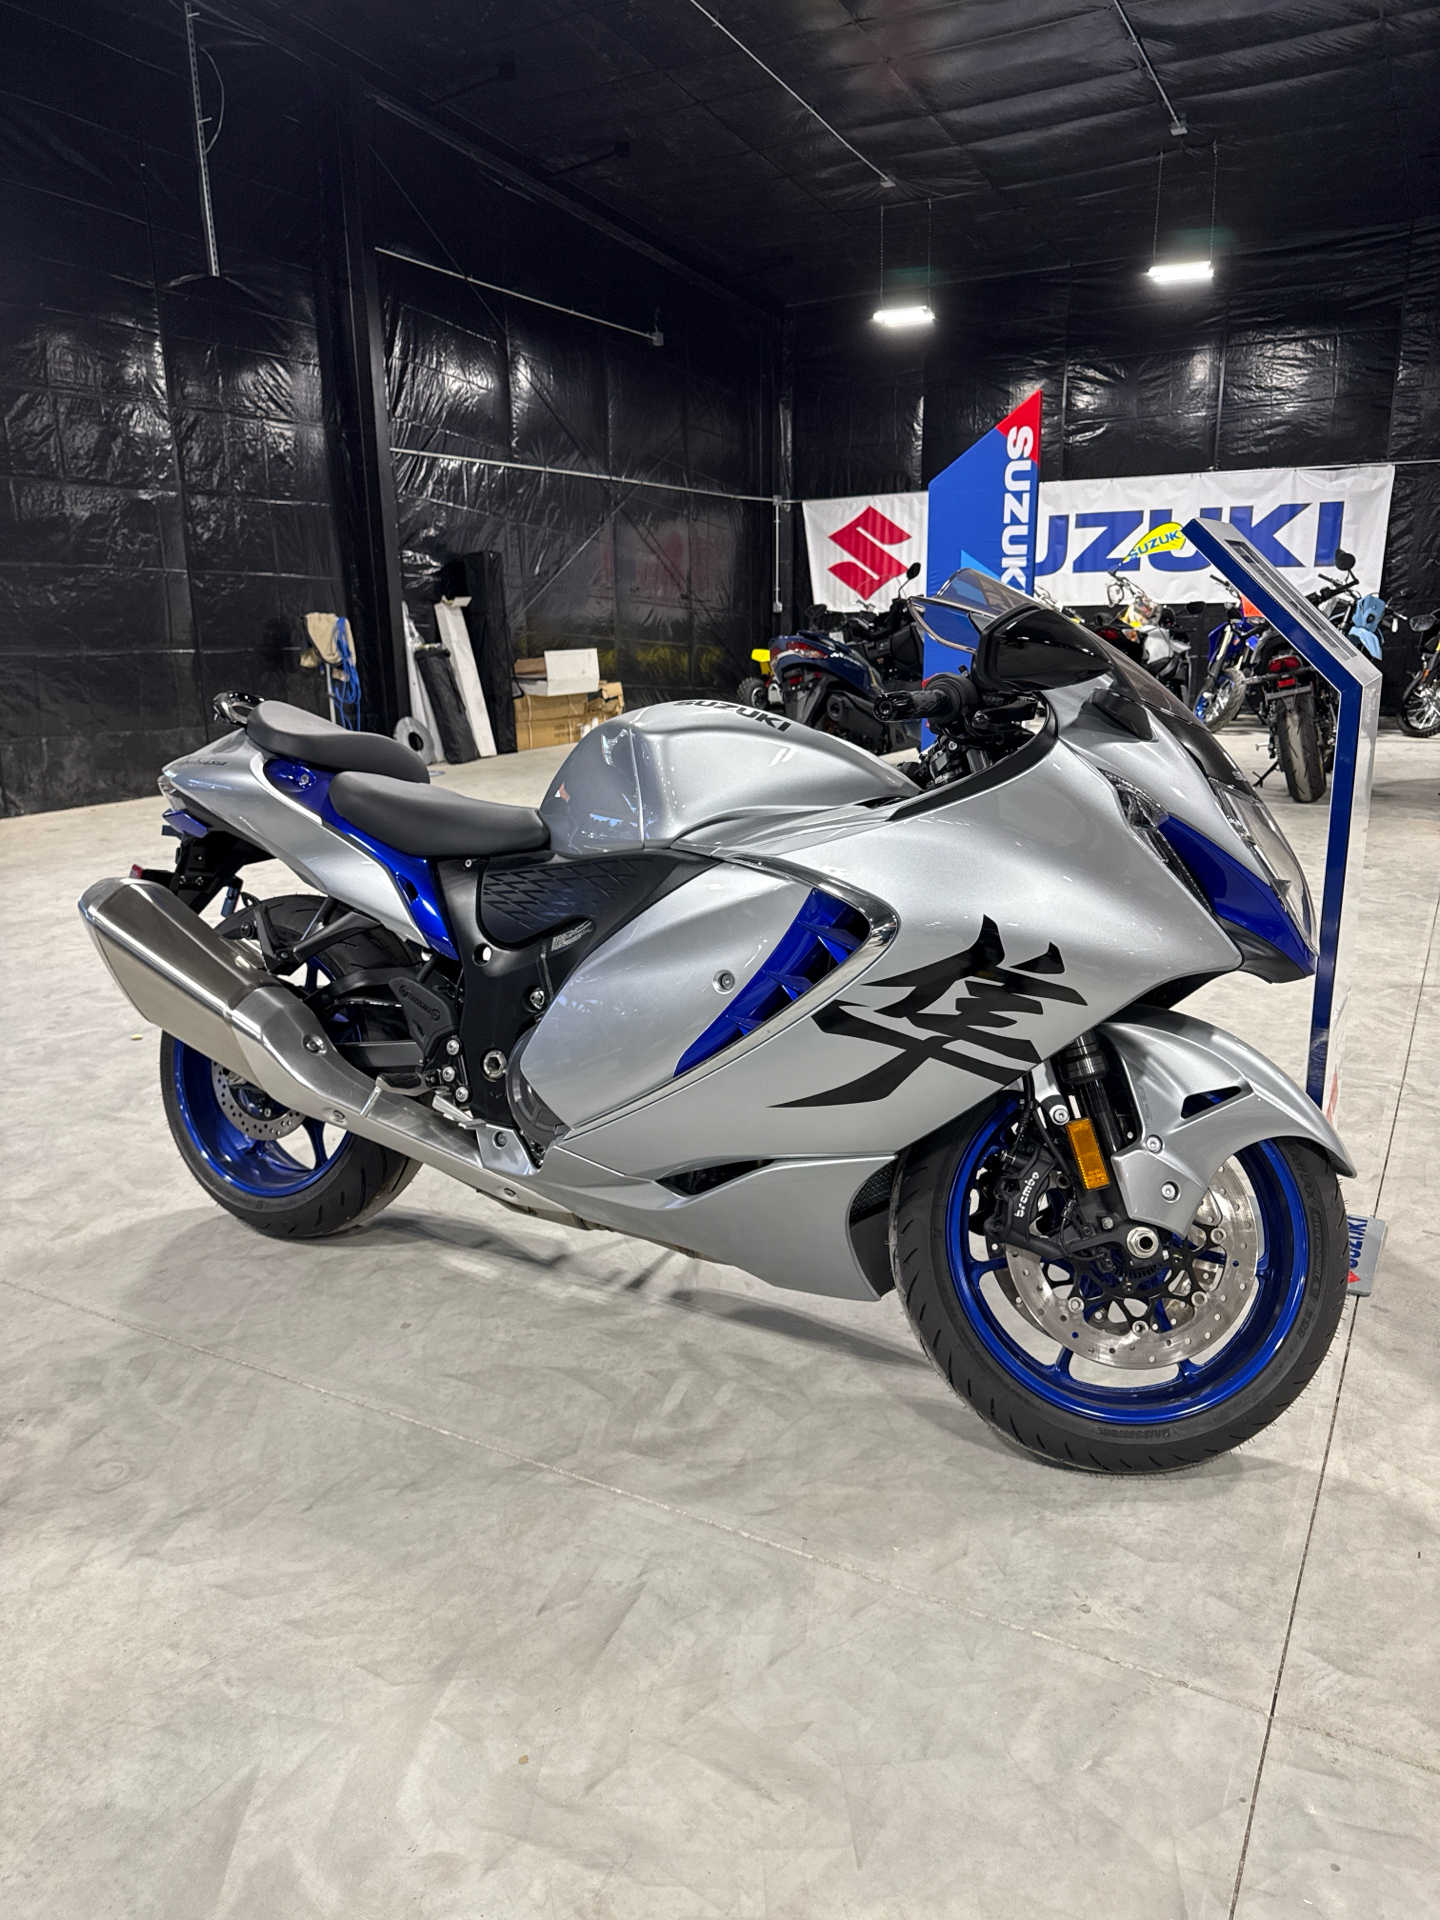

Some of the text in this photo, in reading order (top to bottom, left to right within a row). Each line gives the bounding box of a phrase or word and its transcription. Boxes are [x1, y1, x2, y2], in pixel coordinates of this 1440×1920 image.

[1000, 425, 1034, 593] SUZUK
[1035, 501, 1345, 577] ZUKI
[1128, 530, 1181, 560] SUZUK
[673, 700, 791, 732] SUZUKI
[1014, 1171, 1039, 1218] brembo
